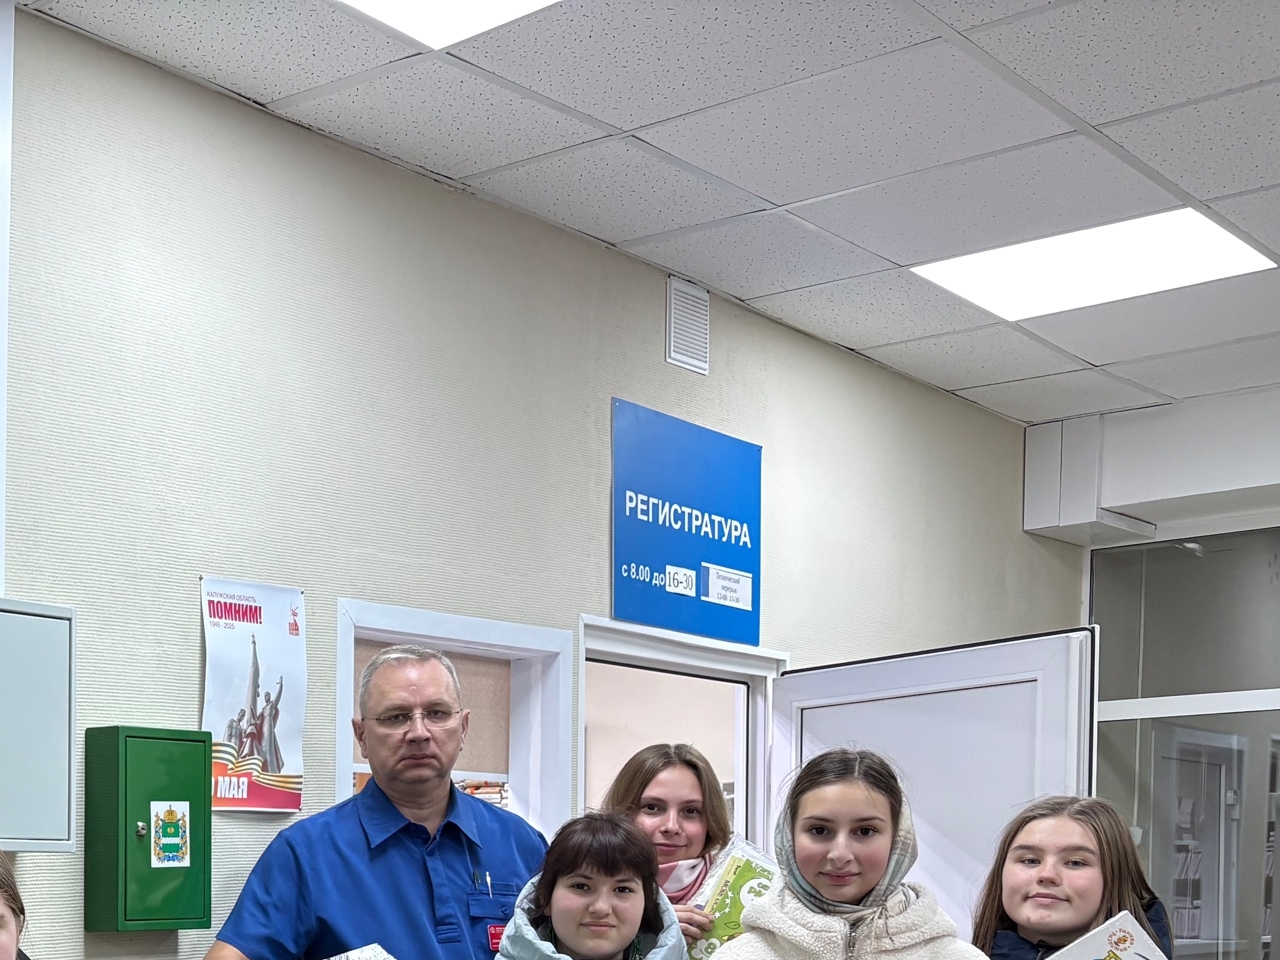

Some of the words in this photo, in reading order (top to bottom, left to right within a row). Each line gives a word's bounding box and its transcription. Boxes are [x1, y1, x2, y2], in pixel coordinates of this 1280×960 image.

[625, 490, 752, 549] РЕГИСТРАТУРА
[621, 564, 628, 577] с
[630, 562, 650, 583] 8.00
[652, 572, 665, 587] до
[667, 571, 694, 591] 16-30
[207, 599, 263, 625] ПОМНИМ!
[216, 775, 248, 799] МАЯ
